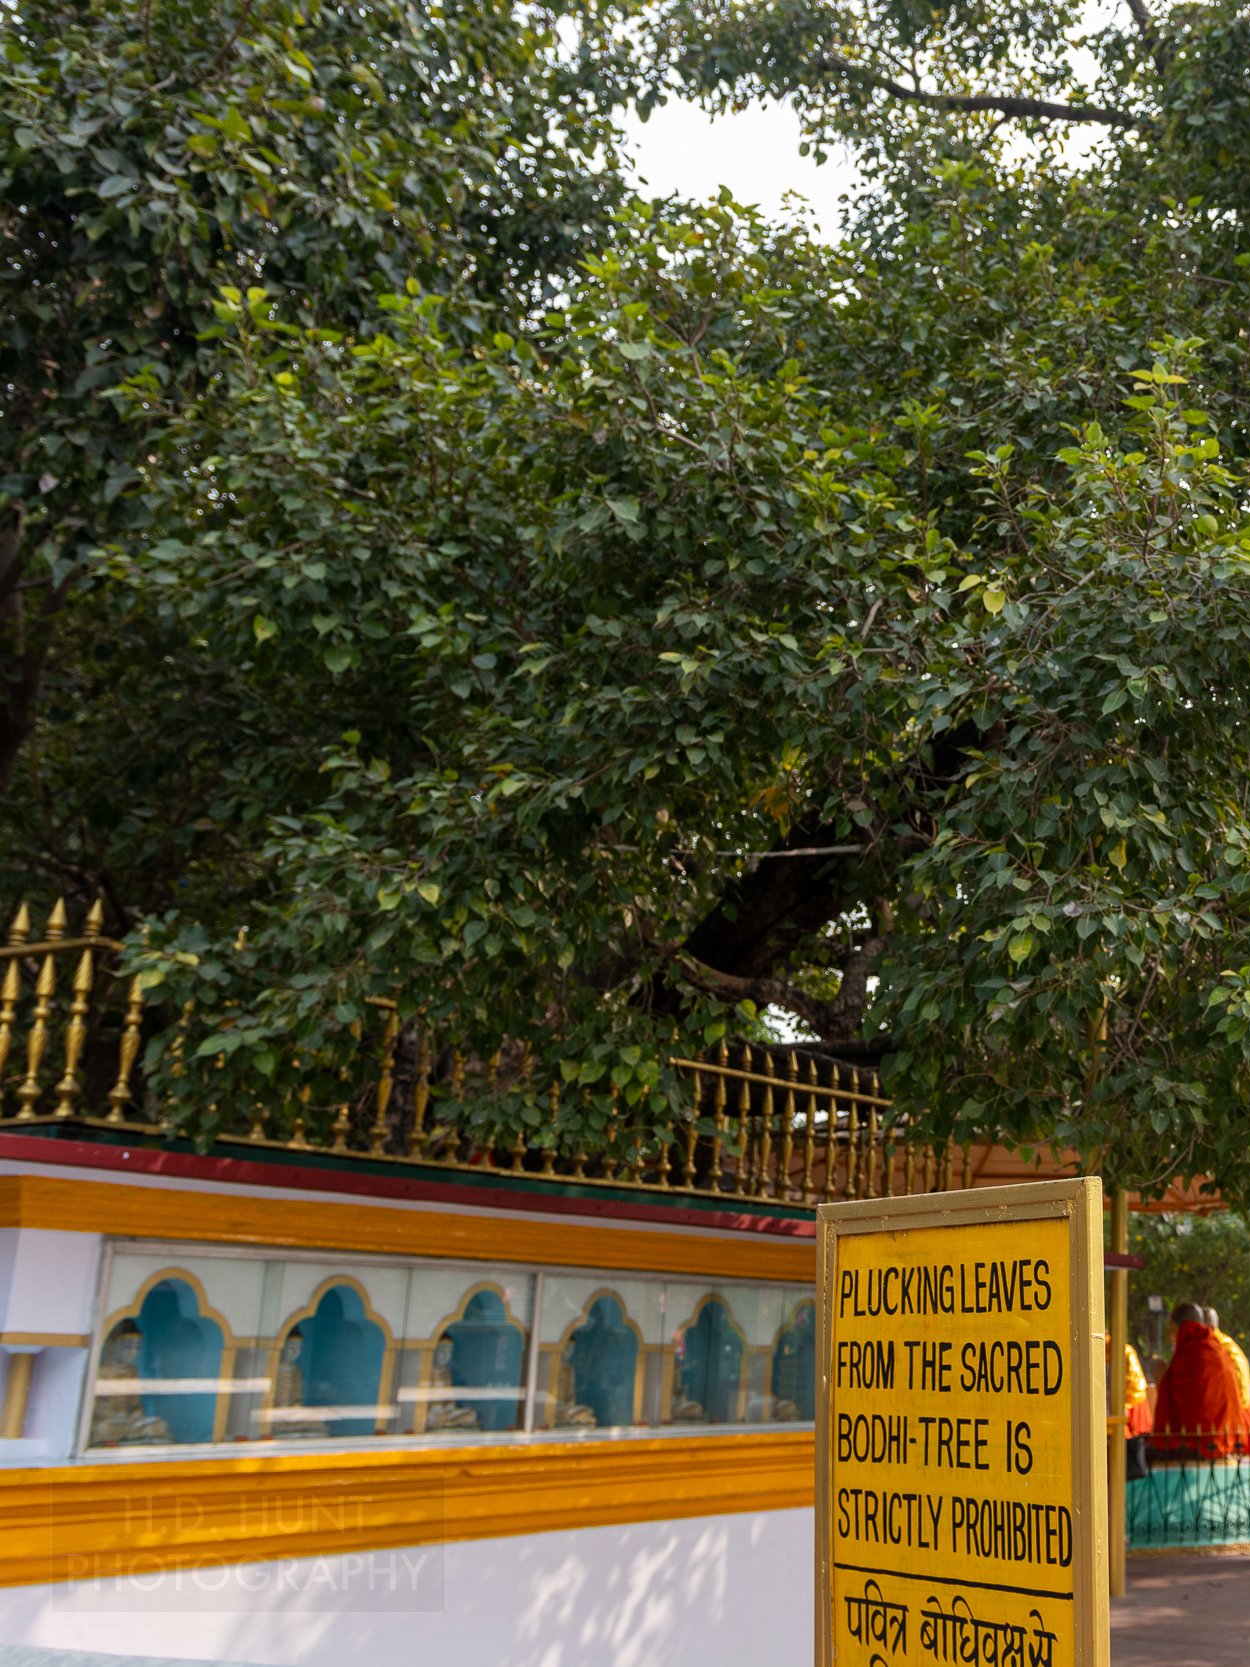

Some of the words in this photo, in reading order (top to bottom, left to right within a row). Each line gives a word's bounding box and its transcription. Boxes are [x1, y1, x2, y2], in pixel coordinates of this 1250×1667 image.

[840, 1263, 955, 1318] PLUCKING
[960, 1258, 1052, 1314] LEAVES
[837, 1340, 895, 1390] FROM
[903, 1340, 953, 1393] THE
[960, 1340, 1063, 1396] SACRED
[837, 1412, 990, 1470] BODHI-TREE
[1006, 1420, 1033, 1475] IS
[837, 1487, 943, 1551] STRICTLY
[951, 1496, 1073, 1568] PROHIBITED
